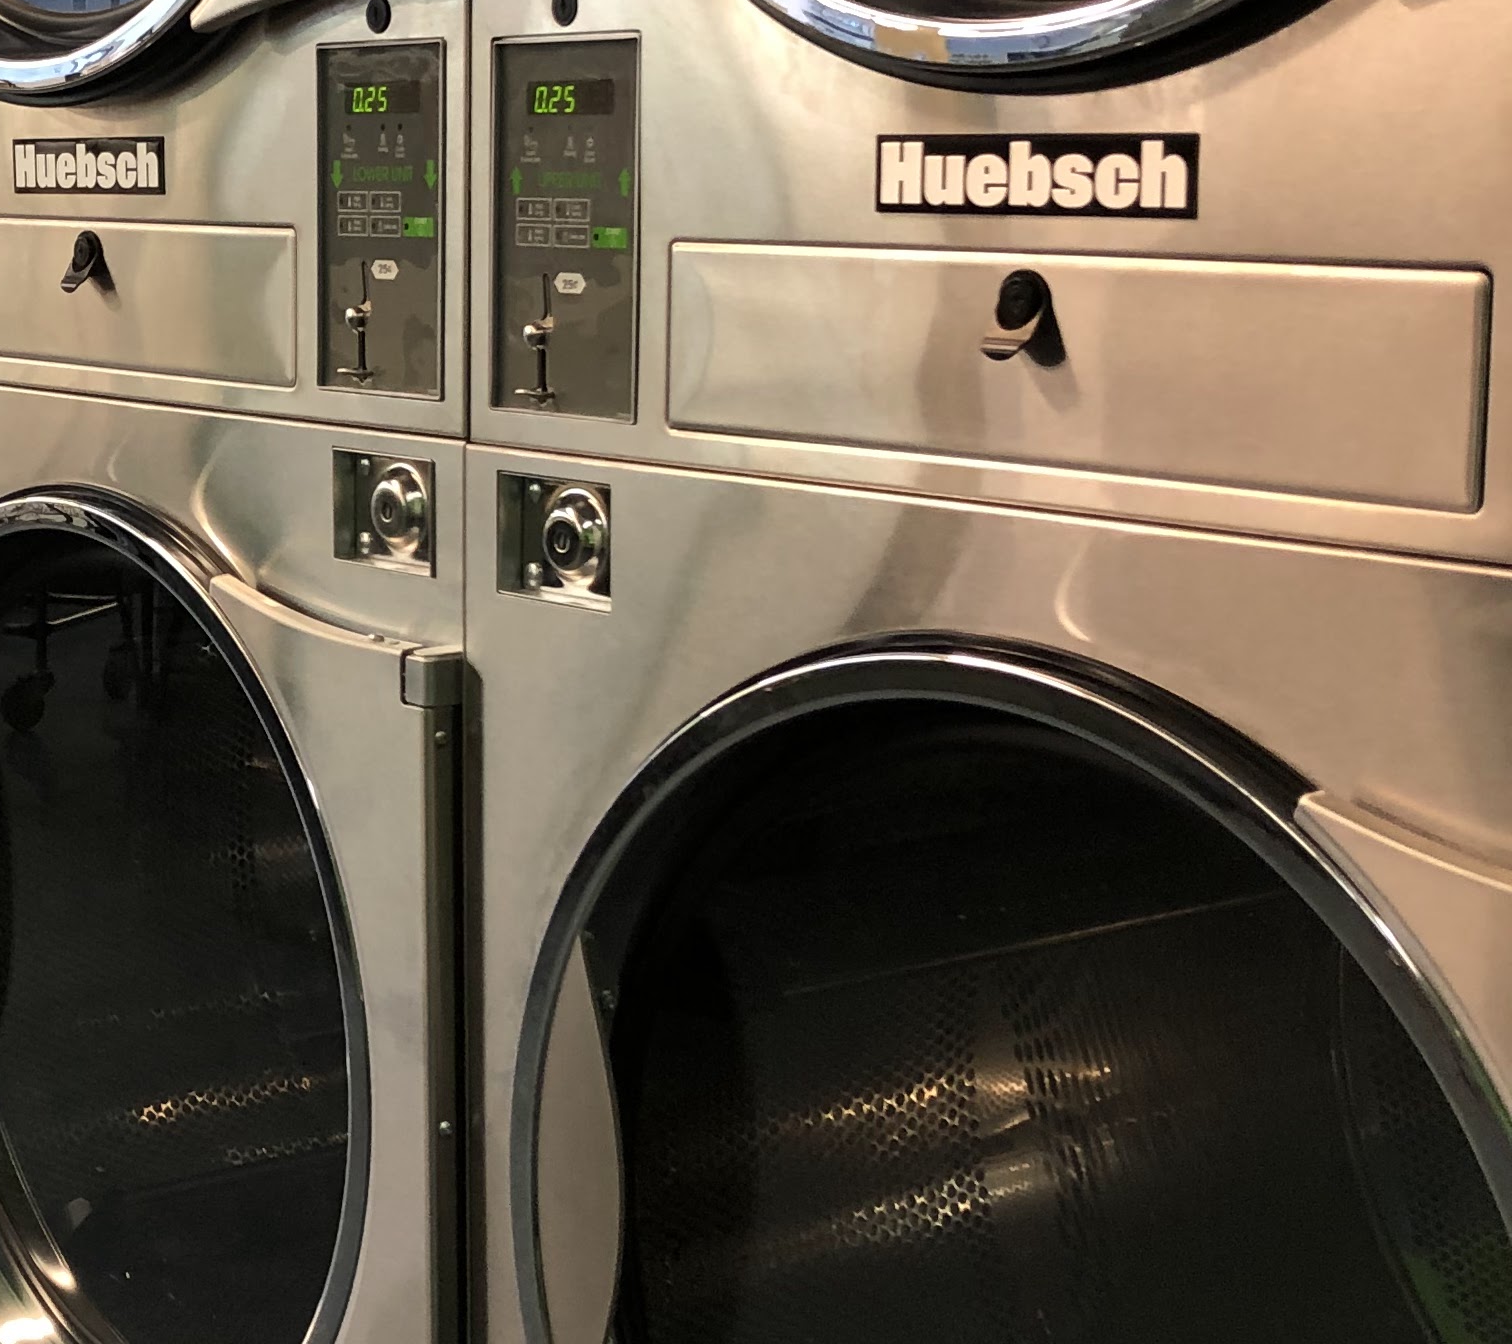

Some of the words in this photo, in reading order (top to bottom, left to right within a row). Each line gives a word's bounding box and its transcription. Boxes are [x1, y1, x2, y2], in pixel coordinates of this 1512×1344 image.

[352, 86, 387, 113] 0.25
[533, 85, 576, 113] 0.25
[14, 142, 159, 189] Huebsch
[880, 140, 1188, 209] Huebsch
